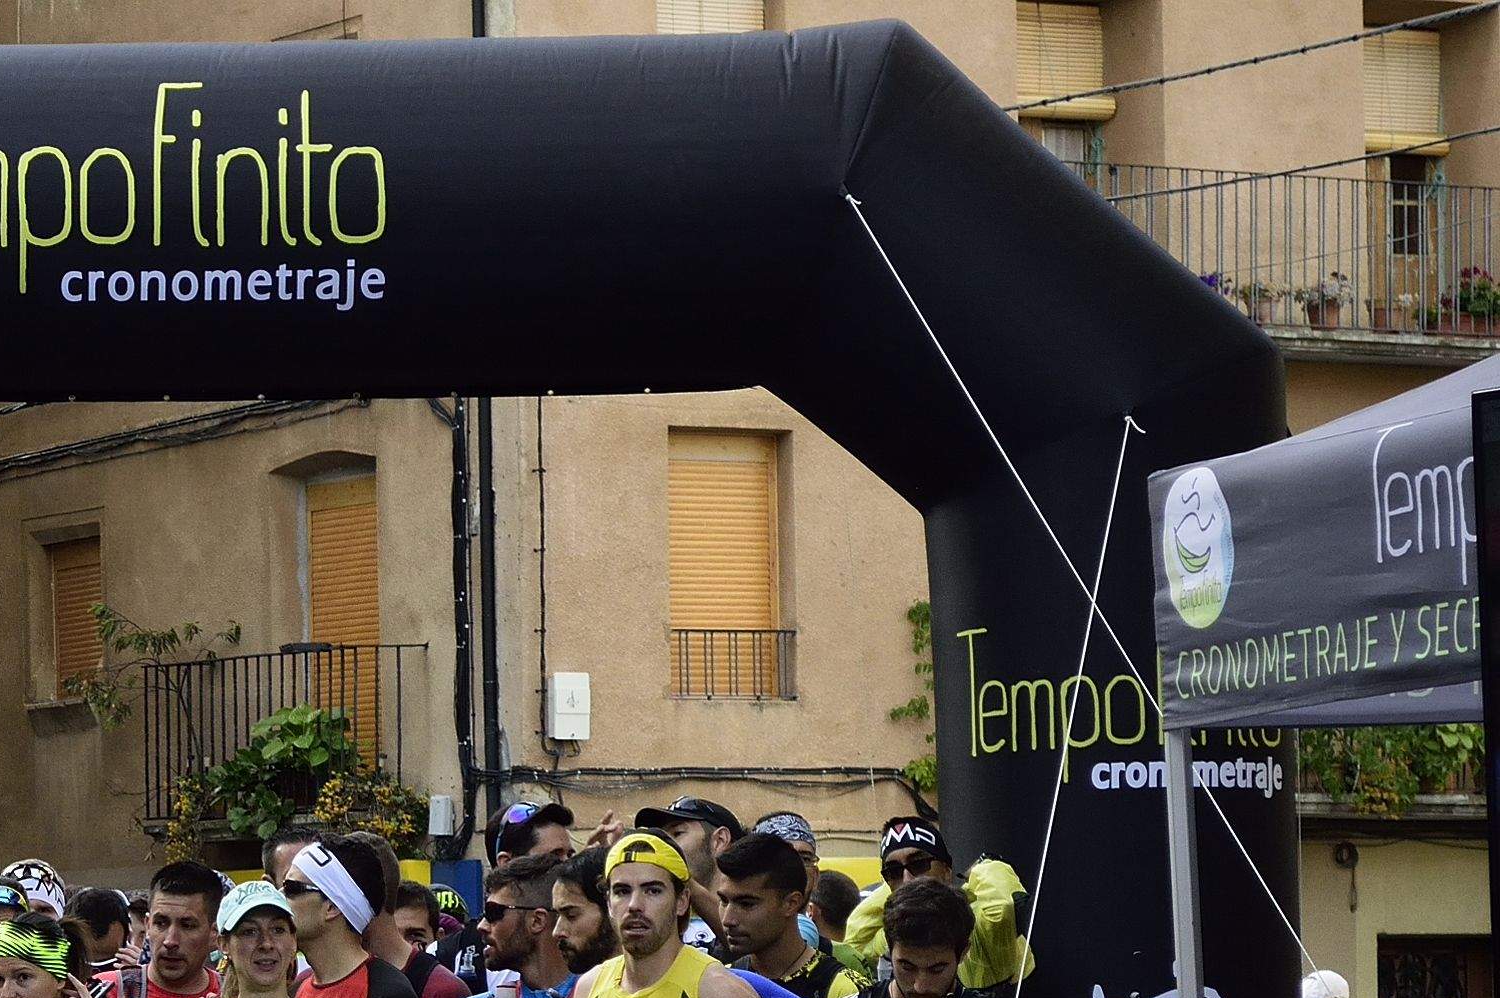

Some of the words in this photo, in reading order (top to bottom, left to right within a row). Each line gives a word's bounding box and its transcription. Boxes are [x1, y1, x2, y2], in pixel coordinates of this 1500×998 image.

[59, 258, 387, 311] cronometraje
[1175, 615, 1379, 700] CRONOMETRAJE
[1390, 609, 1406, 663] Y
[1090, 756, 1284, 799] cronmetraje
